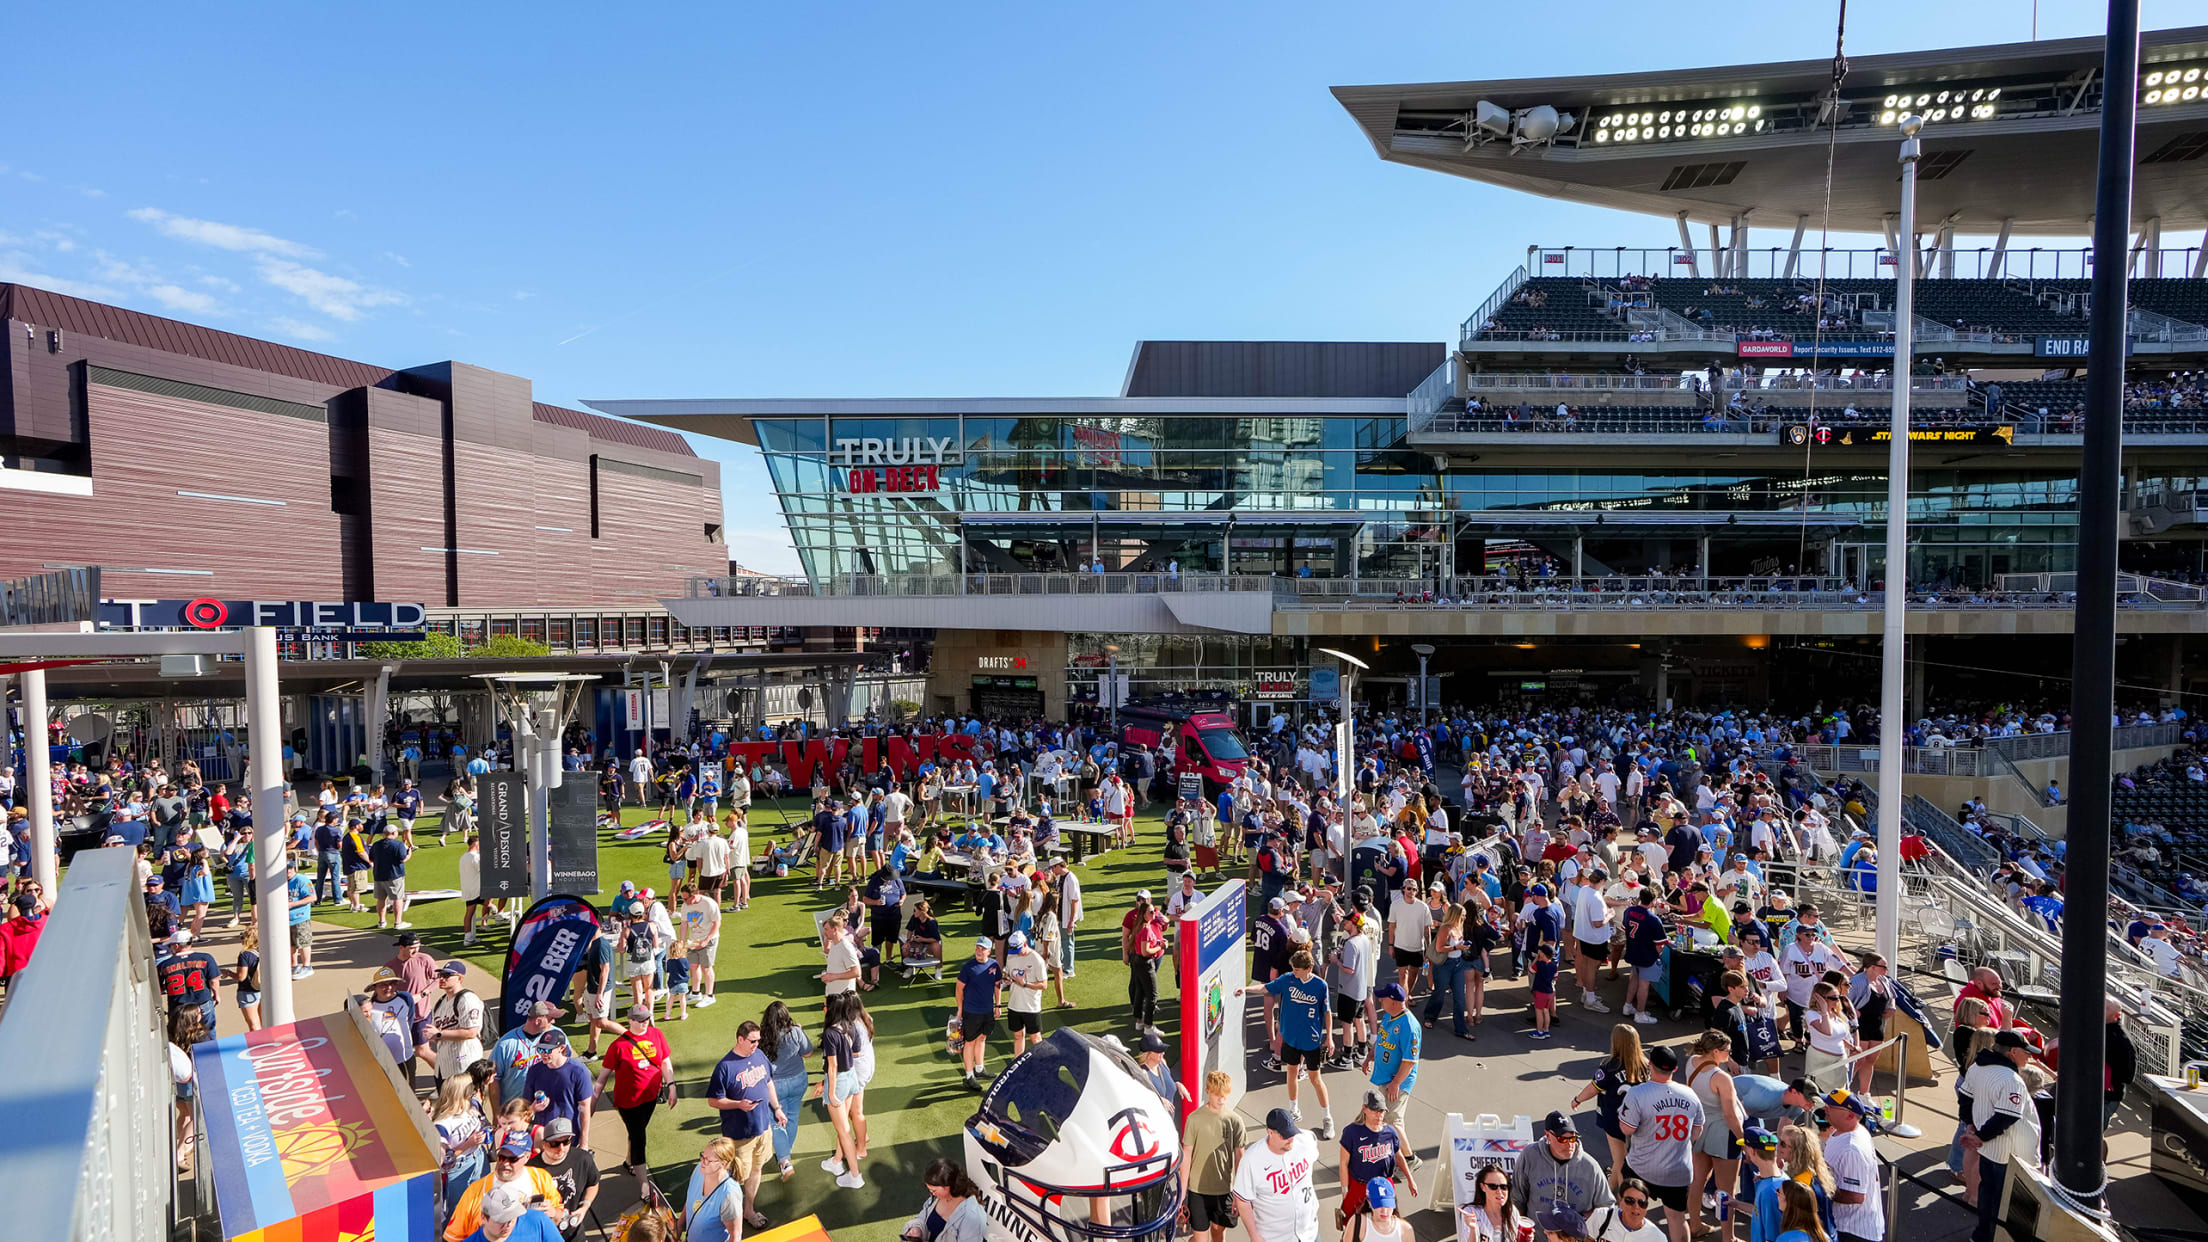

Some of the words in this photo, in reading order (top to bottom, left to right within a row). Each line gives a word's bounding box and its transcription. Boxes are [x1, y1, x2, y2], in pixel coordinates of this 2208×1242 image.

[1793, 346, 1814, 354] Report
[1838, 345, 1858, 354] Issues.
[1859, 345, 1872, 353] Text
[2046, 340, 2070, 354] END
[1908, 431, 1942, 440] WARS
[1944, 431, 1976, 440] NIGHT
[836, 437, 951, 465] TRULY
[849, 469, 876, 494] ON
[885, 465, 940, 492] DECK
[253, 600, 426, 627] FIELD
[978, 656, 1008, 668] DRAFTS
[1014, 656, 1026, 669] 34
[1255, 671, 1297, 682] TRULY
[730, 734, 977, 789] TWINS
[497, 782, 508, 820] GRAND
[500, 831, 511, 868] DESIGN
[2035, 905, 2055, 920] 34
[1255, 930, 1270, 950] 18
[1629, 921, 1640, 938] 7
[540, 928, 581, 973] BEER
[167, 970, 204, 996] 24
[1288, 986, 1318, 1005] Wisco
[1307, 1008, 1316, 1019] 2
[1382, 1050, 1391, 1064] 9
[237, 1037, 346, 1126] Surfside
[984, 1052, 1033, 1114] CHEVROLET
[231, 1085, 258, 1106] ICED
[1652, 1098, 1690, 1112] WALLNER
[236, 1104, 262, 1127] TEA
[1655, 1114, 1689, 1141] 38
[241, 1129, 275, 1168] VODKA
[1358, 1142, 1393, 1163] Twins
[1470, 1156, 1502, 1169] CHEERS
[1266, 1157, 1310, 1195] Twins
